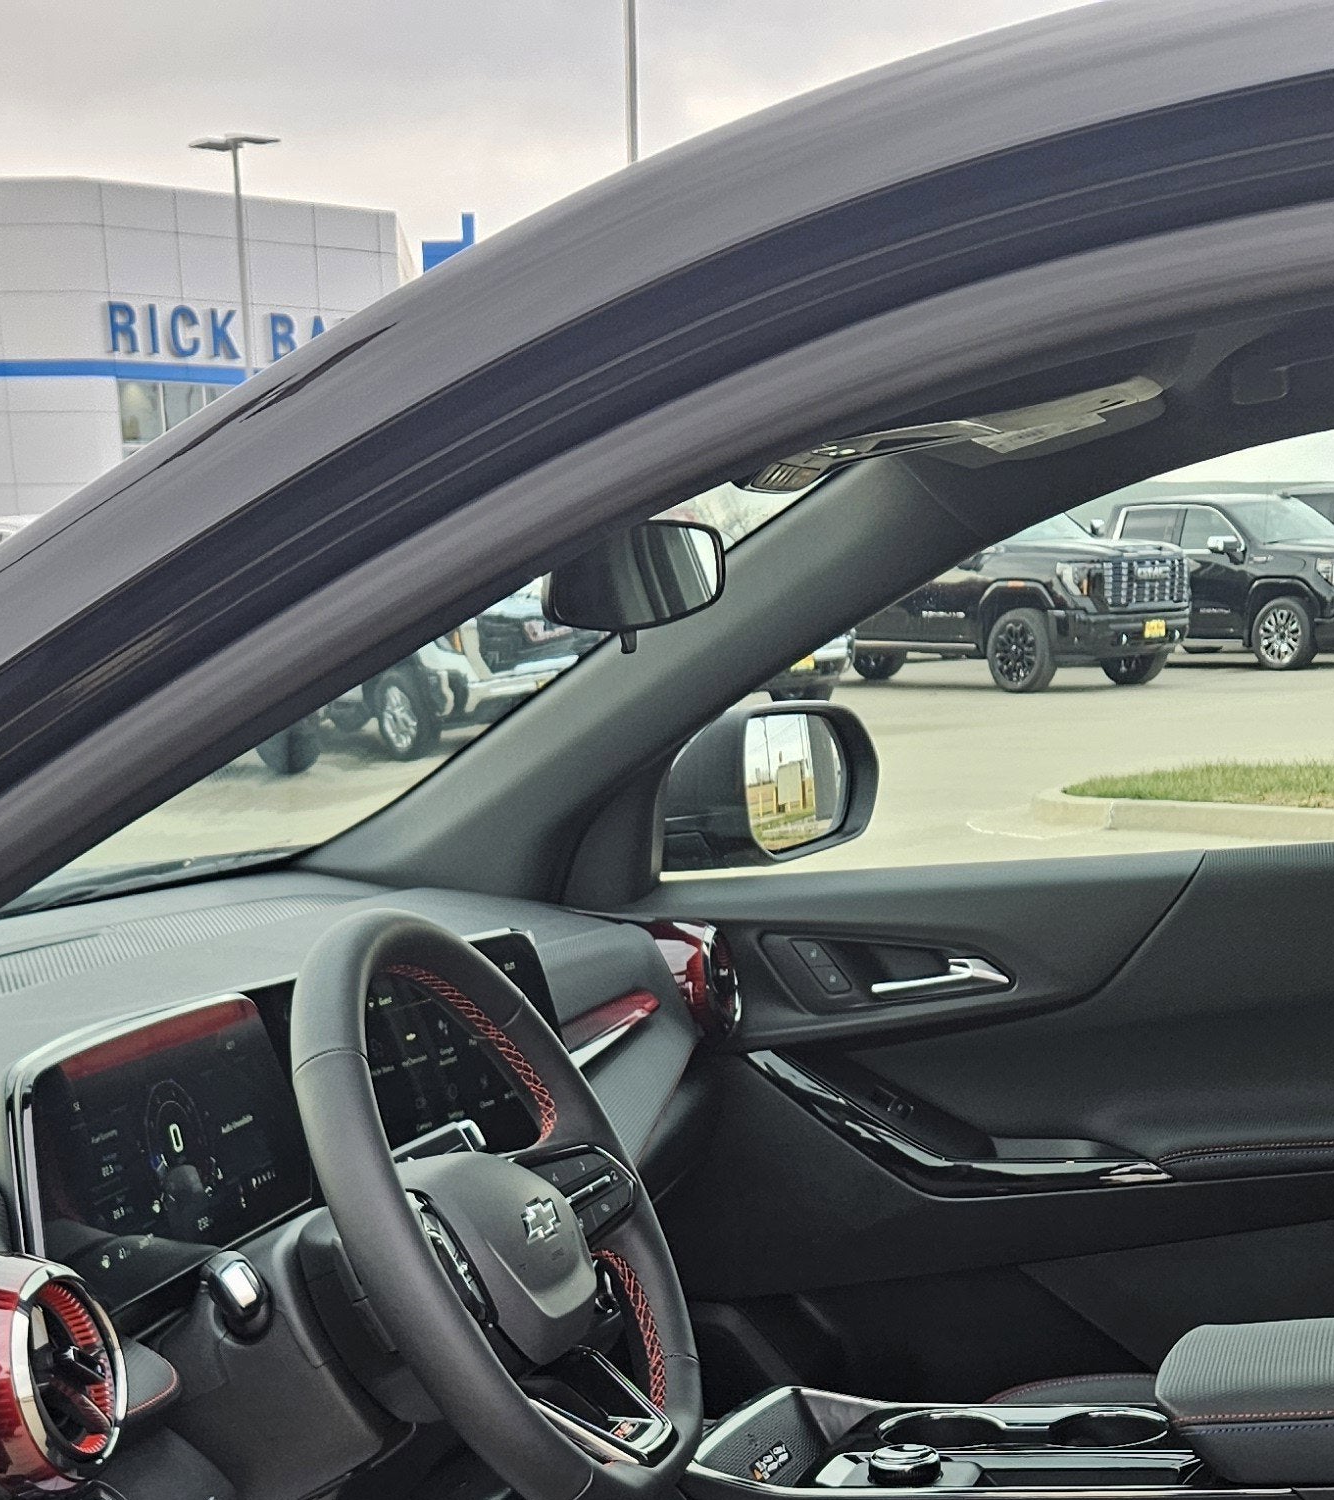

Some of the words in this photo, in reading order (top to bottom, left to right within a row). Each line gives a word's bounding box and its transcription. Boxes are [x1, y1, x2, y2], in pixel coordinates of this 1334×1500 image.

[108, 300, 242, 360] RICK
[270, 312, 344, 362] BA
[1137, 566, 1171, 580] GMC
[169, 1123, 184, 1153] 0
